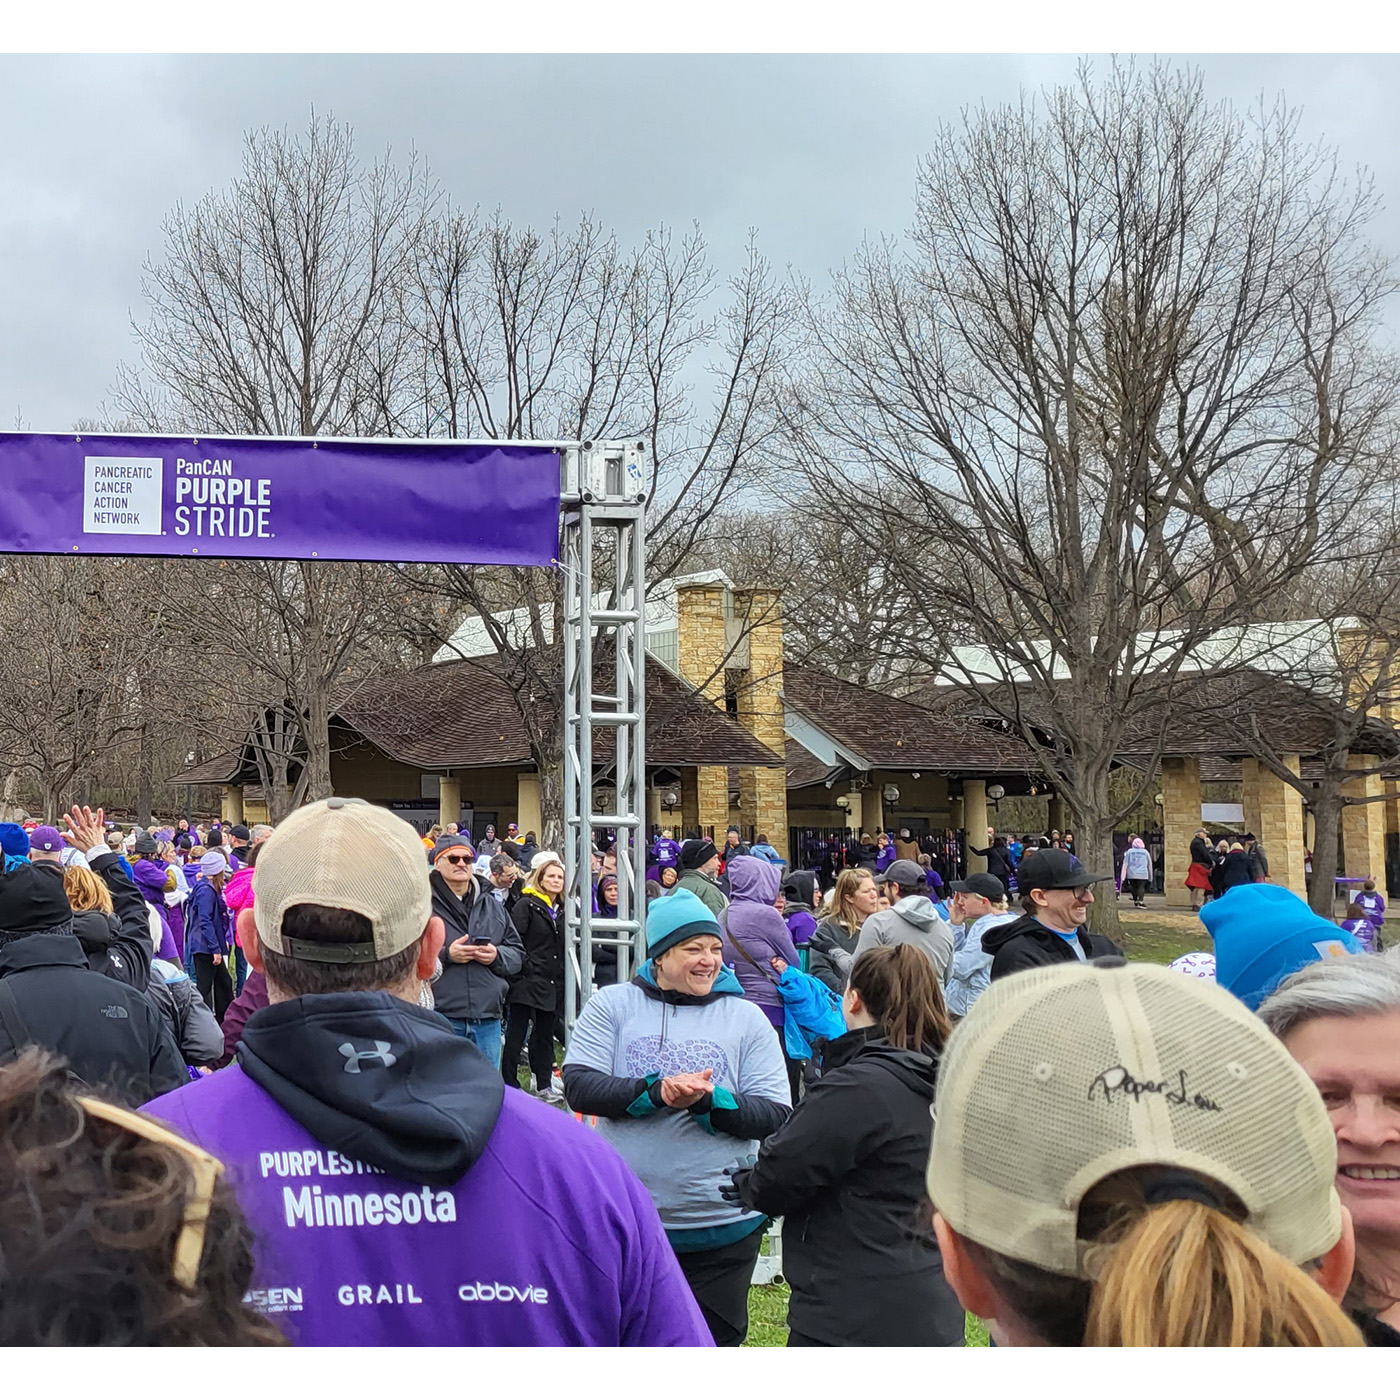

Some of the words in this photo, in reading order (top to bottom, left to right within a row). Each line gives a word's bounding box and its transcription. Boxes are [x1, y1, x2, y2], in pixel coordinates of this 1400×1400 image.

[94, 465, 153, 480] PANCREATIC
[176, 458, 232, 477] PanCAN
[94, 481, 133, 495] CANCER
[175, 477, 271, 506] PURPLE
[93, 496, 129, 510] ACTION
[93, 511, 141, 526] NETWORK
[282, 1185, 457, 1228] Minnesota
[241, 1286, 303, 1306] SEN
[337, 1283, 423, 1306] GRAIL
[458, 1280, 549, 1304] abbvie
